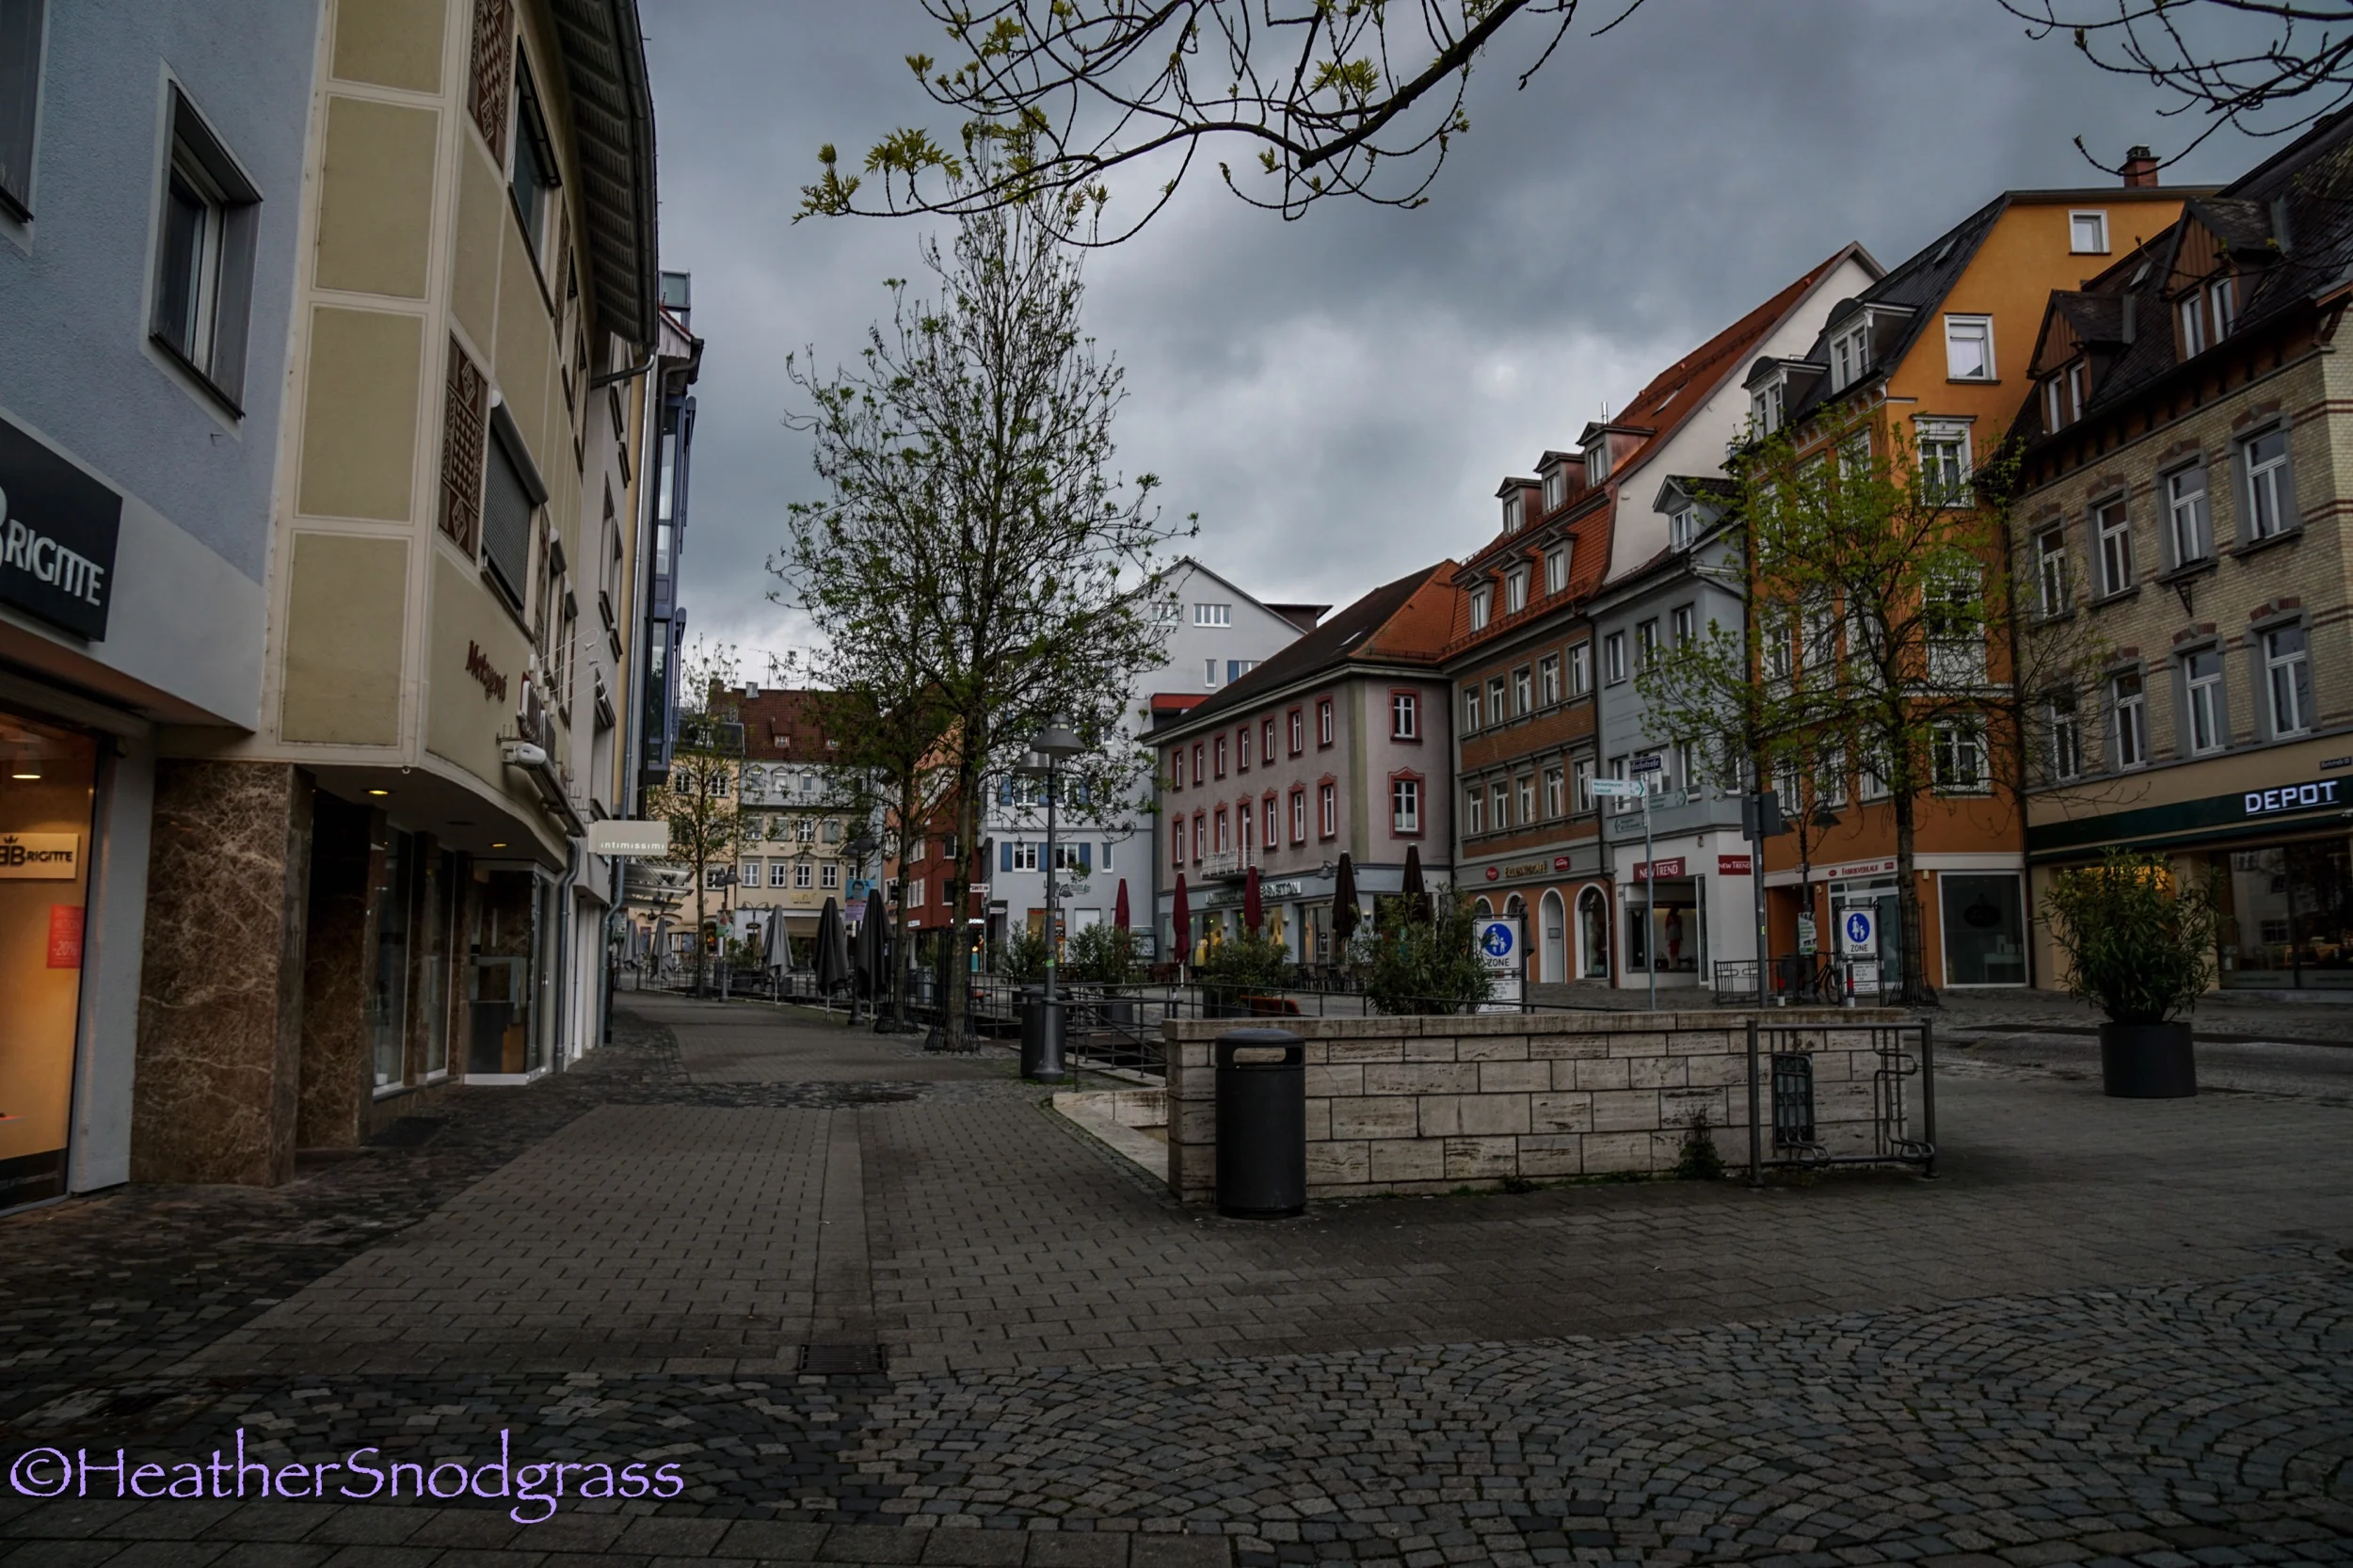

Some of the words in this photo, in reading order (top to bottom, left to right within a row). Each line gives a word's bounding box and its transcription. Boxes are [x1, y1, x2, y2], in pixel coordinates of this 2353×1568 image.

[0, 486, 105, 607] RIGITTE
[2244, 780, 2339, 813] DEPOT
[600, 840, 664, 850] intimissimi
[1655, 860, 1678, 877] TREND
[1732, 860, 1751, 870] TREND
[1850, 944, 1868, 952] ZONE
[1487, 958, 1510, 968] ZONE
